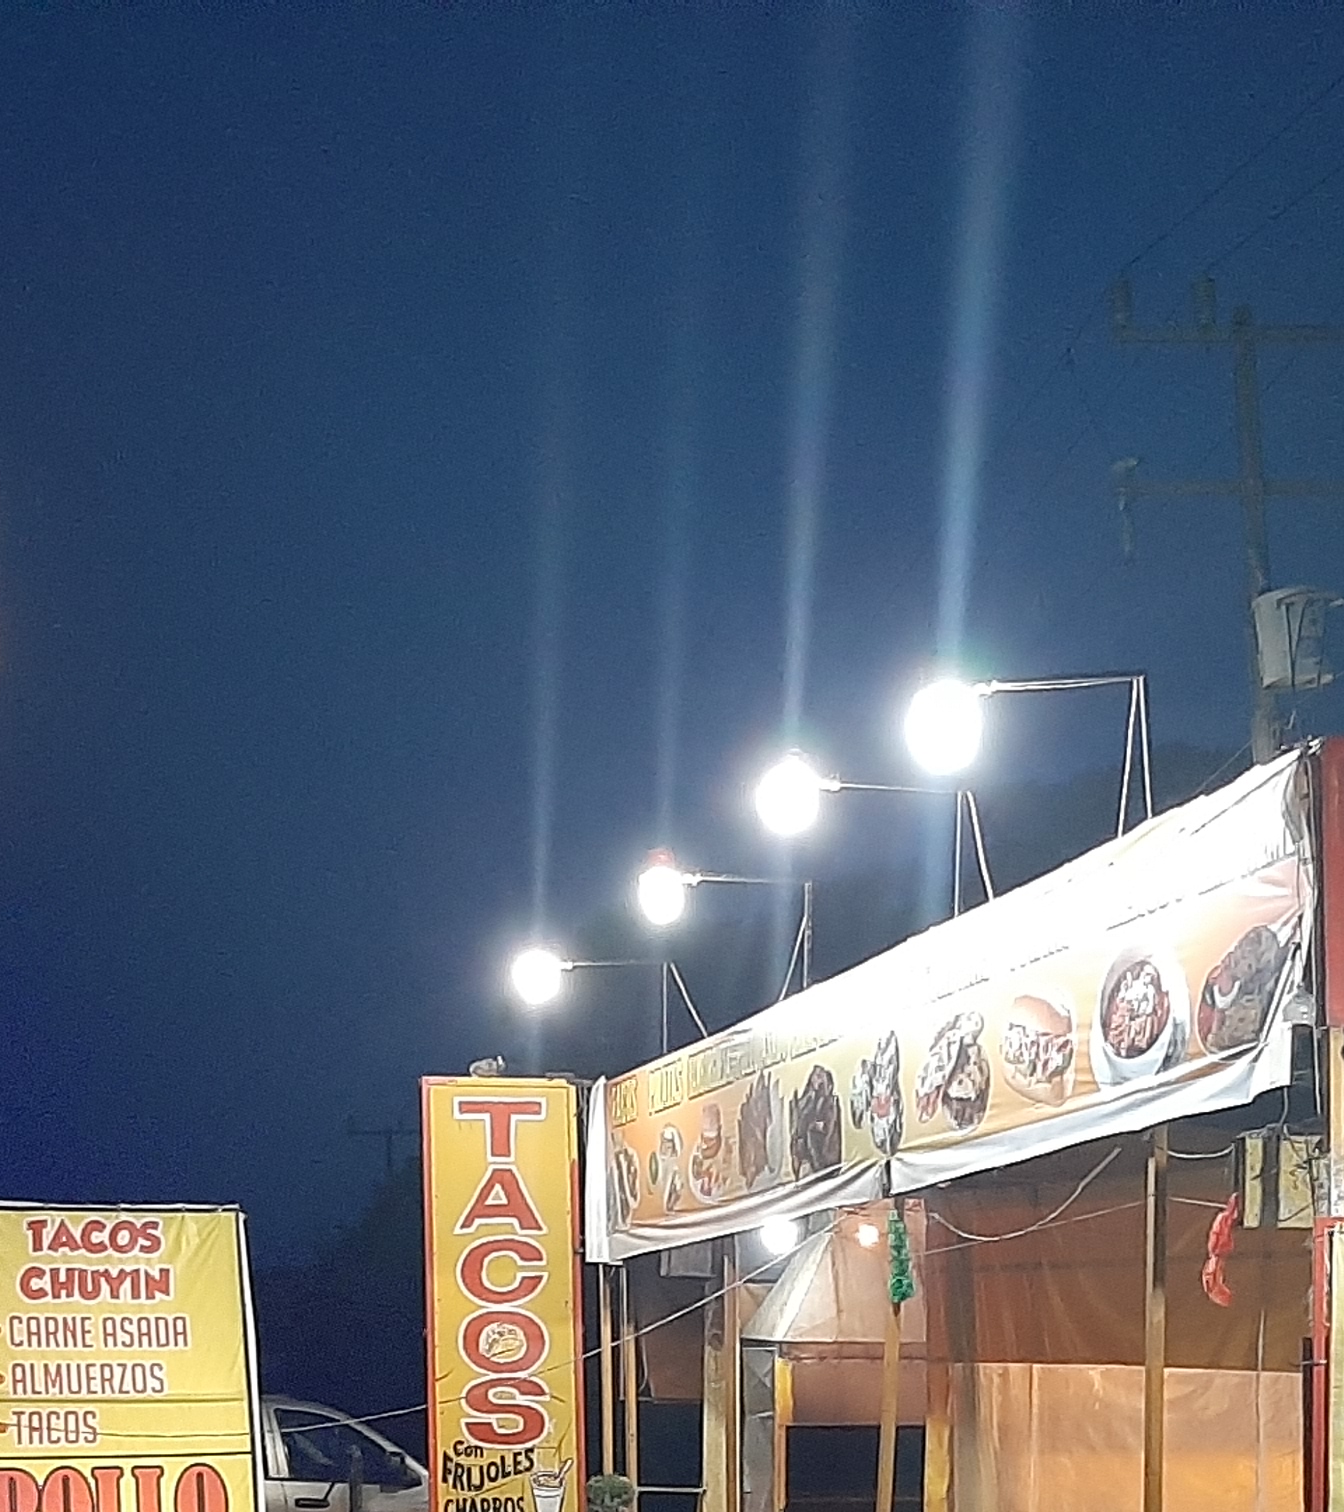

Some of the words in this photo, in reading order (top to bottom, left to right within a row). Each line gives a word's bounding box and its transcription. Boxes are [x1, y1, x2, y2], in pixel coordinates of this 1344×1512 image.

[26, 1219, 162, 1254] TACOS
[20, 1266, 172, 1300] CHUYIN
[455, 1099, 549, 1448] TACOS
[9, 1315, 94, 1348] CARNE
[102, 1316, 189, 1348] ASADA
[11, 1363, 165, 1395] ALMUERZOS
[12, 1410, 97, 1445] TACOS
[453, 1440, 484, 1458] Con
[441, 1448, 535, 1492] FRIJOLES
